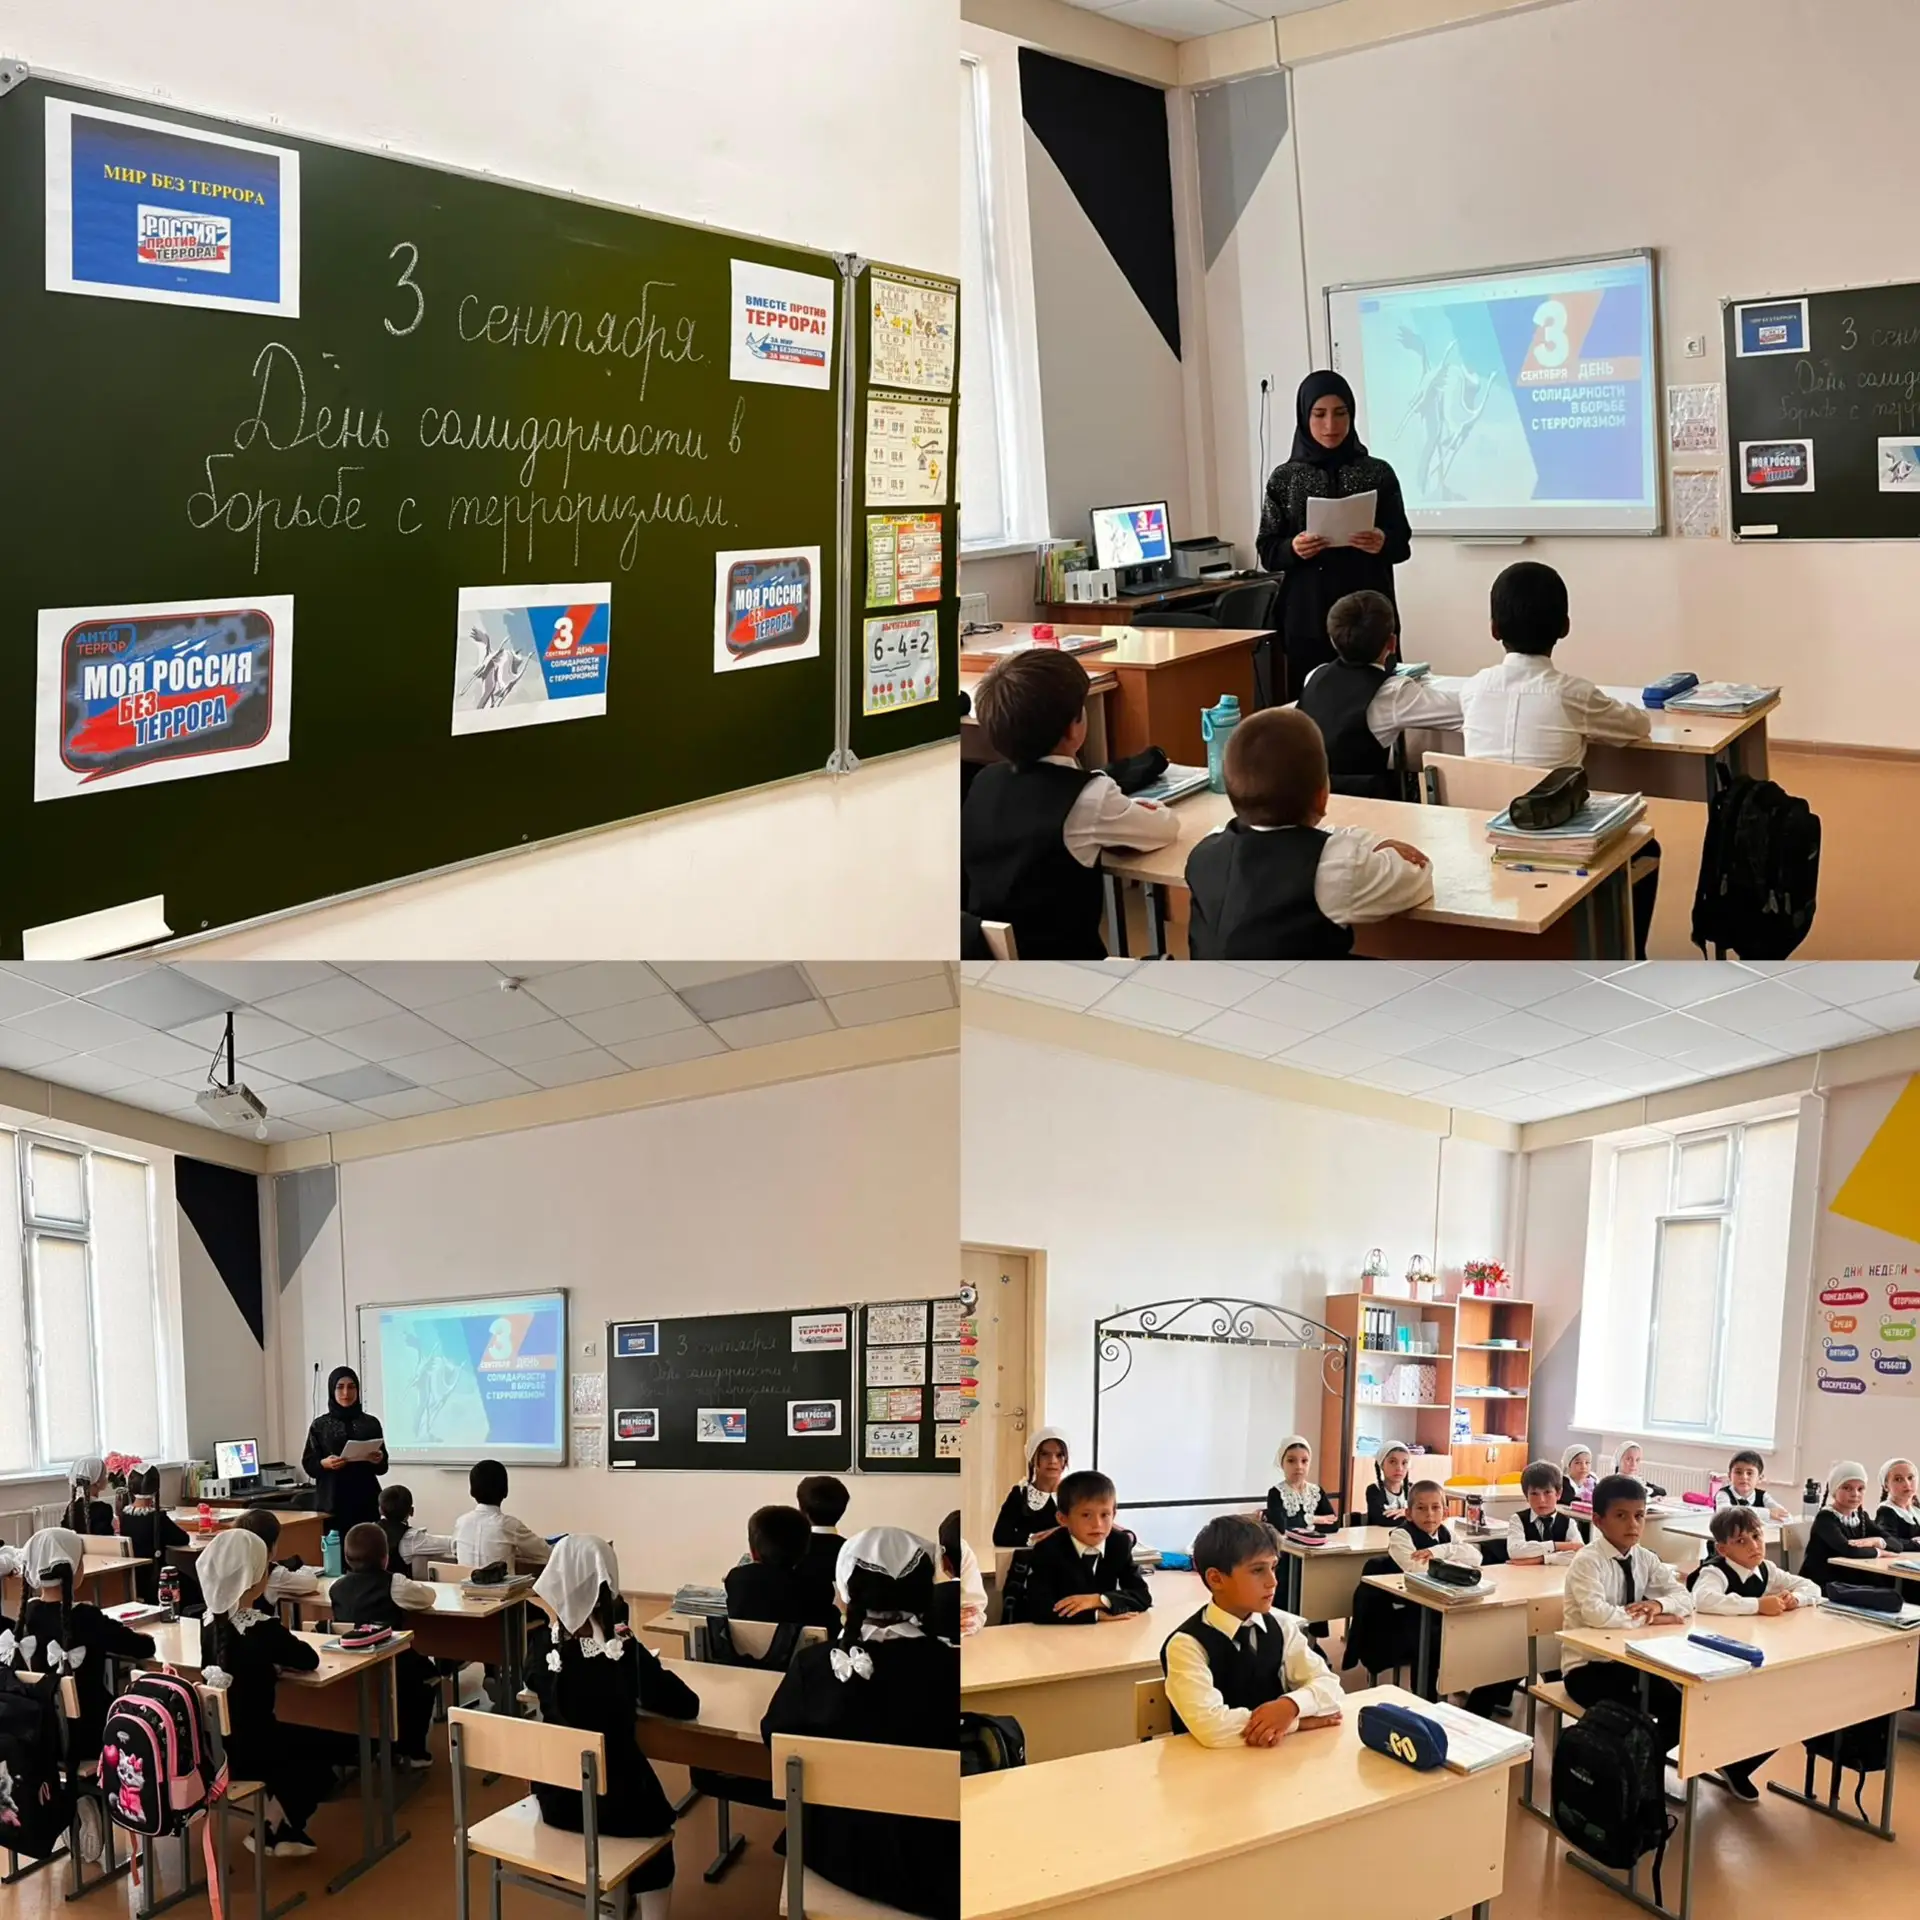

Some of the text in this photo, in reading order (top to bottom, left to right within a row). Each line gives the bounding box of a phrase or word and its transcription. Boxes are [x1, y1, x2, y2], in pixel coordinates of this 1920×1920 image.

[103, 164, 265, 205] МИР БЕЗ ТЕРРОРА
[145, 215, 218, 245] РОССИЯ
[147, 237, 198, 249] ПРОТИВ
[156, 247, 217, 261] ТЕРРОРА!
[384, 242, 425, 336] 3
[745, 295, 827, 318] ВМЕСТЕ ПРОТИВ
[745, 308, 826, 335] ТЕРРОРА!
[771, 336, 779, 344] ЗА
[1533, 300, 1569, 367] 3
[1841, 317, 1858, 351] 3
[770, 344, 824, 358] ЗА БЕЗОПАСНОСТЬ
[1521, 362, 1614, 381] СЕНТЯБРЯ ДЕНЬ
[234, 342, 389, 450] День
[729, 396, 746, 454] в
[1532, 385, 1626, 402] СОЛИДАРНОСТИ
[1571, 400, 1626, 414] В БОРЬБЕ
[1532, 415, 1626, 430] С ТЕРРОРИЗМОМ
[187, 453, 366, 574] борьбе
[398, 498, 422, 534] с
[735, 583, 802, 610] МОЯ РОССИЯ
[76, 630, 119, 644] АНТИ
[553, 617, 574, 650] 3
[76, 641, 129, 656] ТЕРРОР
[576, 645, 595, 656] ДЕНЬ
[551, 656, 599, 668] СОЛИДАРНОСТИ
[83, 651, 253, 700] МОЯ РОССИЯ
[555, 671, 599, 682] ТЕРРОРИЗМОМ
[118, 690, 158, 725] БЕЗ
[134, 695, 228, 747] ТЕРРОРА
[1844, 1264, 1908, 1278] ДНИ НЕДЕЛИ
[1822, 1291, 1865, 1301] ПОНЕДЕЛЬНИК
[488, 1318, 512, 1360] 3
[799, 1327, 842, 1335] ТЕРРОРА!
[677, 1334, 688, 1356] 3
[1878, 1361, 1907, 1370] СУББОТА
